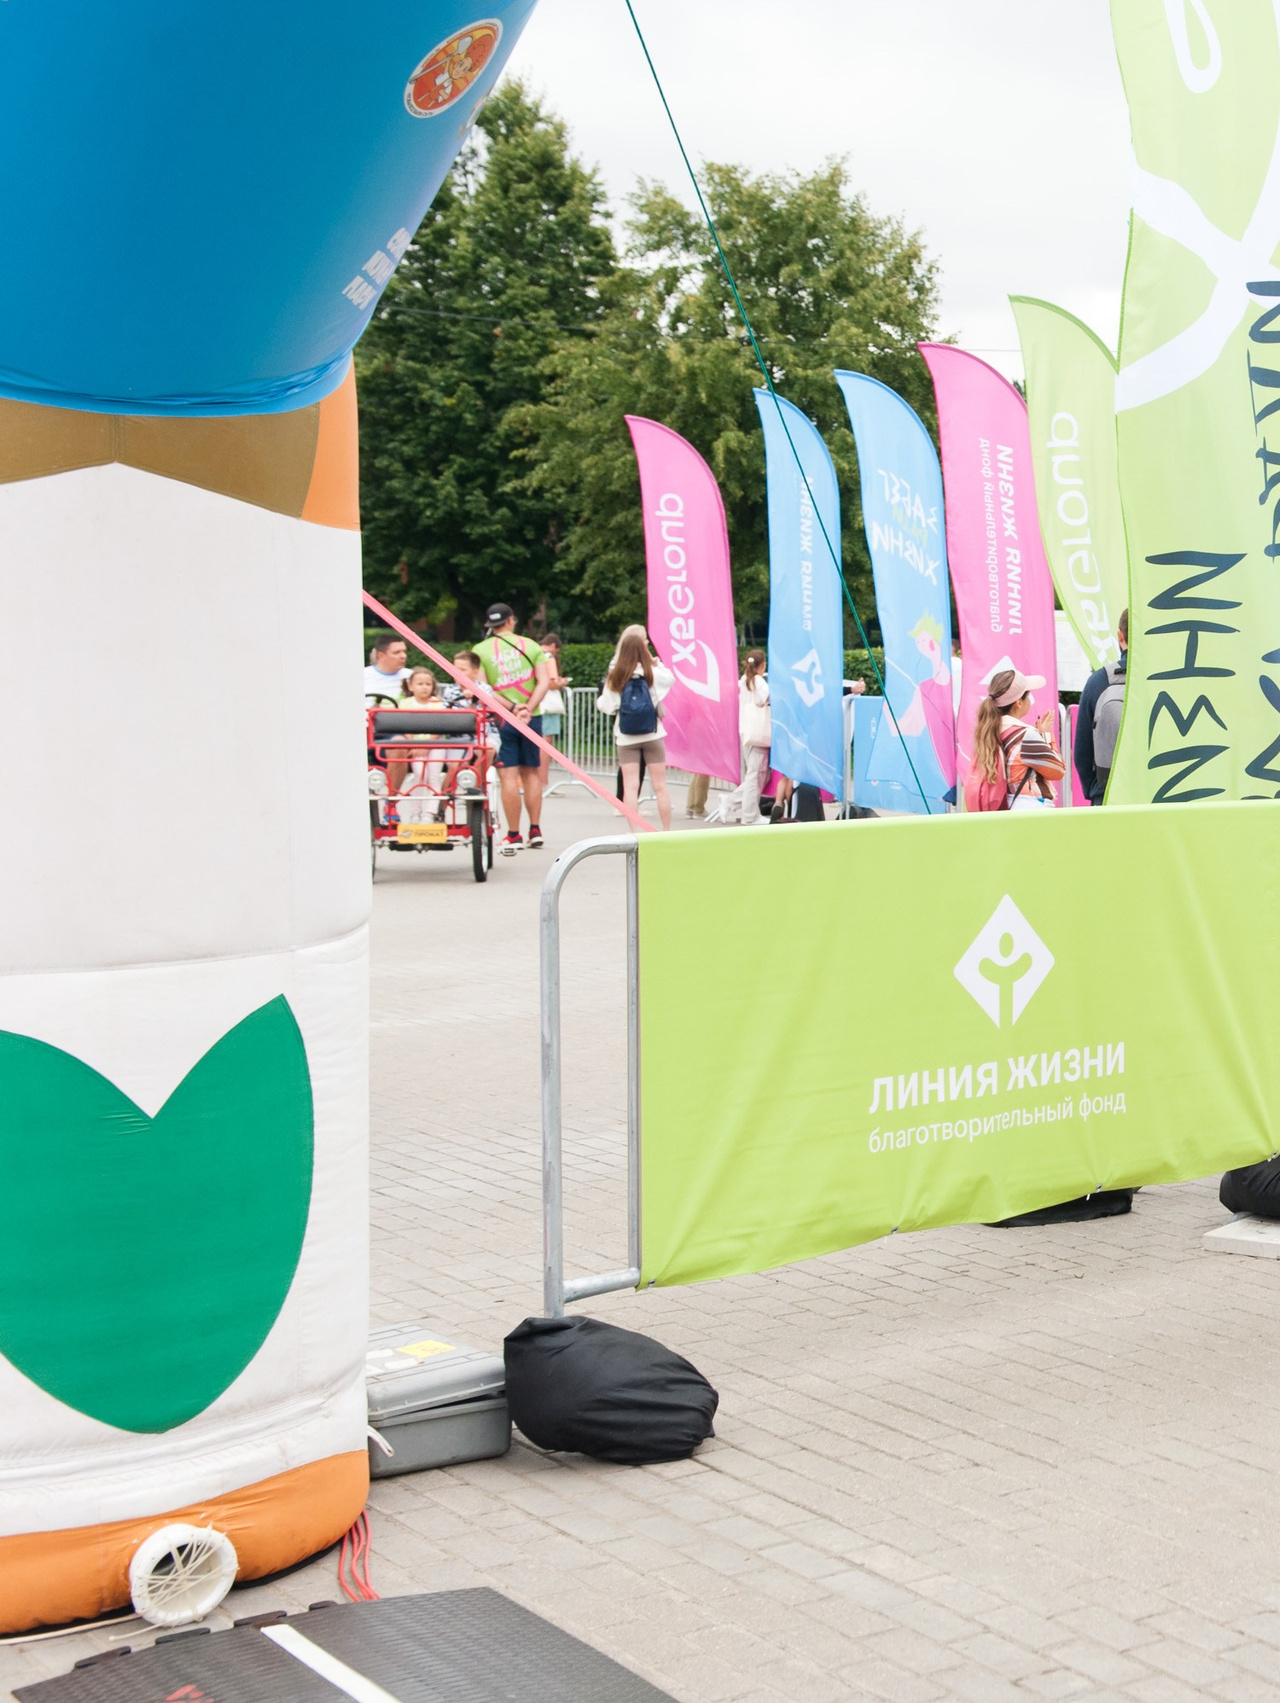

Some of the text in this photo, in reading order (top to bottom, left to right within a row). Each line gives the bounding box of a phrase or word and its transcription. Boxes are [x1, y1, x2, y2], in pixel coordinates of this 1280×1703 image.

[868, 1041, 1126, 1114] ЛИНИЯ ЖИЗНИ
[868, 1092, 1127, 1154] благотворительный фонд
